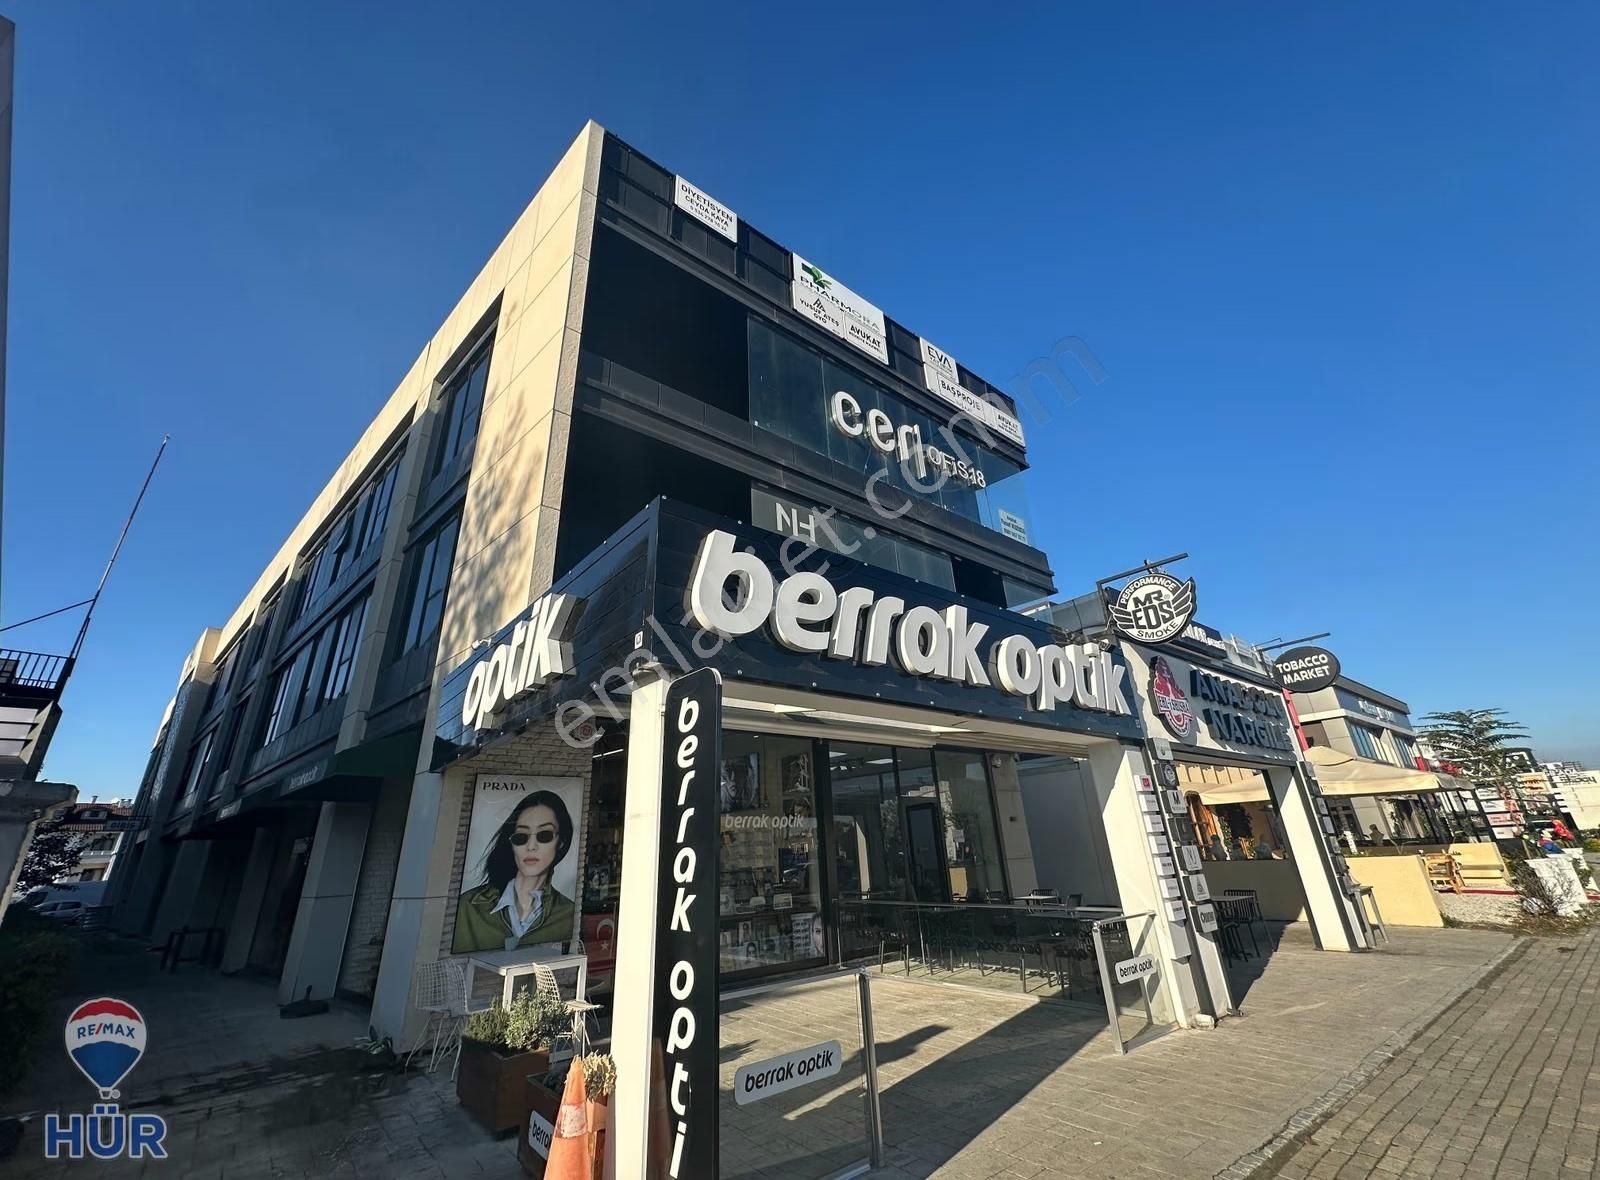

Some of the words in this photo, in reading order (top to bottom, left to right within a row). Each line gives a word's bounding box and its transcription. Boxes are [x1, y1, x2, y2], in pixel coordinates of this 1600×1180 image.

[681, 184, 733, 223] DİYETİSYEN
[685, 195, 710, 214] CEYDA
[711, 211, 729, 227] KAYA
[800, 276, 880, 331] PHARMORA
[800, 298, 822, 315] YUSUF
[850, 324, 881, 348] AVUKAT
[927, 345, 953, 369] EVA
[1120, 575, 1177, 605] PERFORMANCE
[690, 528, 992, 687] berrak
[995, 633, 1132, 716] optik
[1131, 600, 1175, 630] EDS
[1136, 620, 1179, 639] SMOKE
[462, 592, 568, 732] optik
[1275, 653, 1329, 674] TOBACCO
[1282, 665, 1330, 685] MARKET
[482, 781, 527, 792] PRADA
[669, 696, 700, 933] berrak
[725, 813, 769, 829] berrak
[771, 813, 804, 829] optik
[1119, 963, 1139, 977] berrak
[1138, 958, 1154, 973] optik
[744, 1061, 796, 1093] berrak
[796, 1049, 834, 1077] optik
